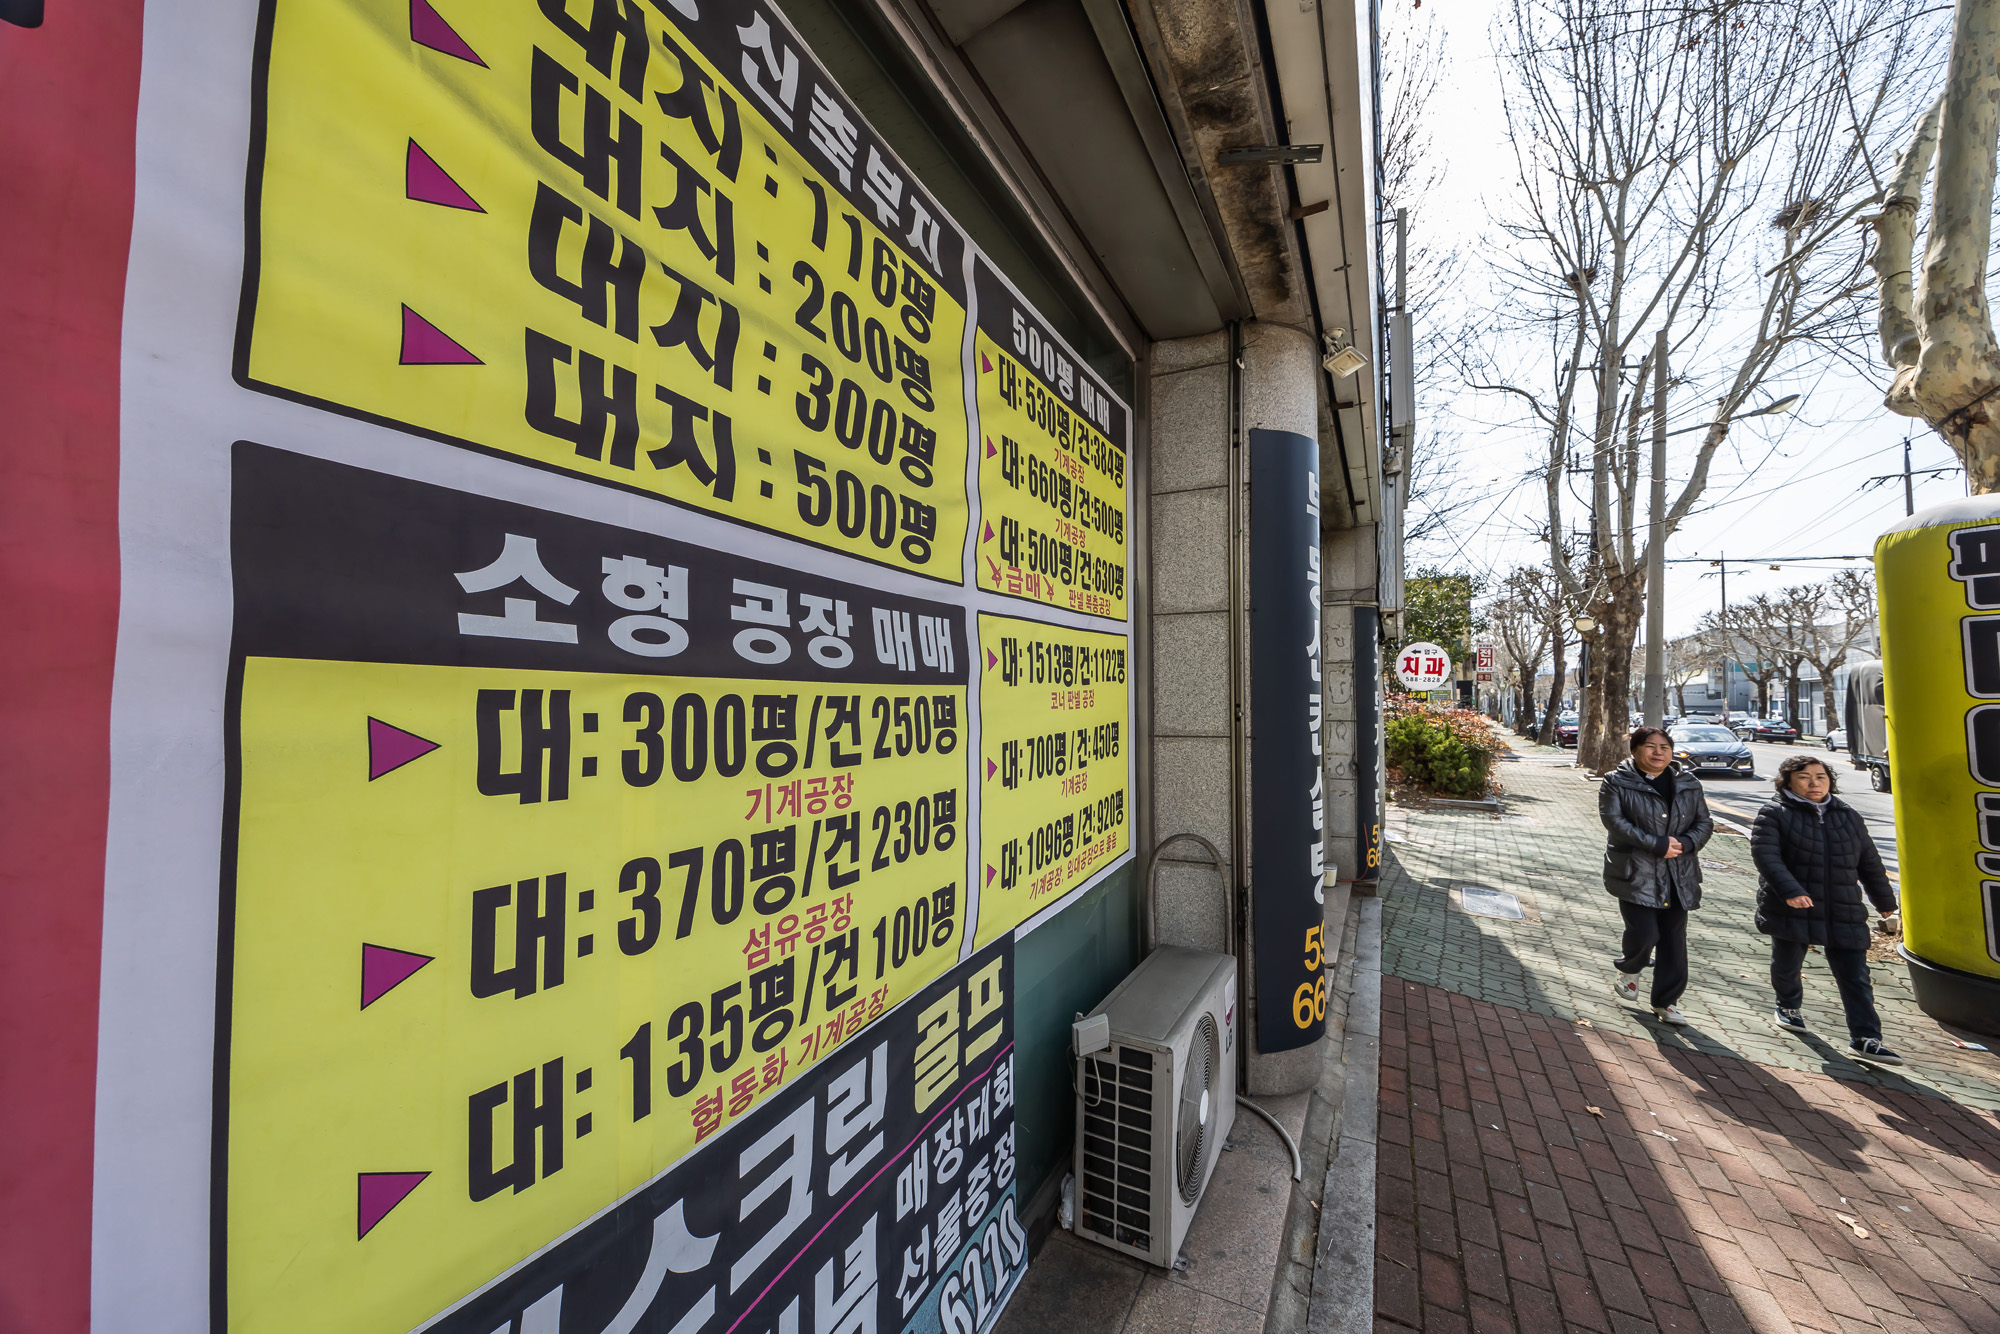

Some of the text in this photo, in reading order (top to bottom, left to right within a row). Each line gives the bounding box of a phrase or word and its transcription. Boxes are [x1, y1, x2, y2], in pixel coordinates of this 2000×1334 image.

[1013, 308, 1110, 435] 500평 매매
[1054, 448, 1085, 484] 기계공장
[1055, 518, 1086, 549] 기계공장
[454, 533, 956, 673] 소형 공장 매매
[1006, 565, 1041, 600] 급매
[1402, 656, 1445, 677] 치과
[1480, 649, 1492, 667] 전기
[744, 772, 855, 825] 기계공장
[741, 892, 855, 971] 섬유공장
[914, 954, 1004, 1115] 골프
[691, 985, 889, 1145] 협동화 기계공장
